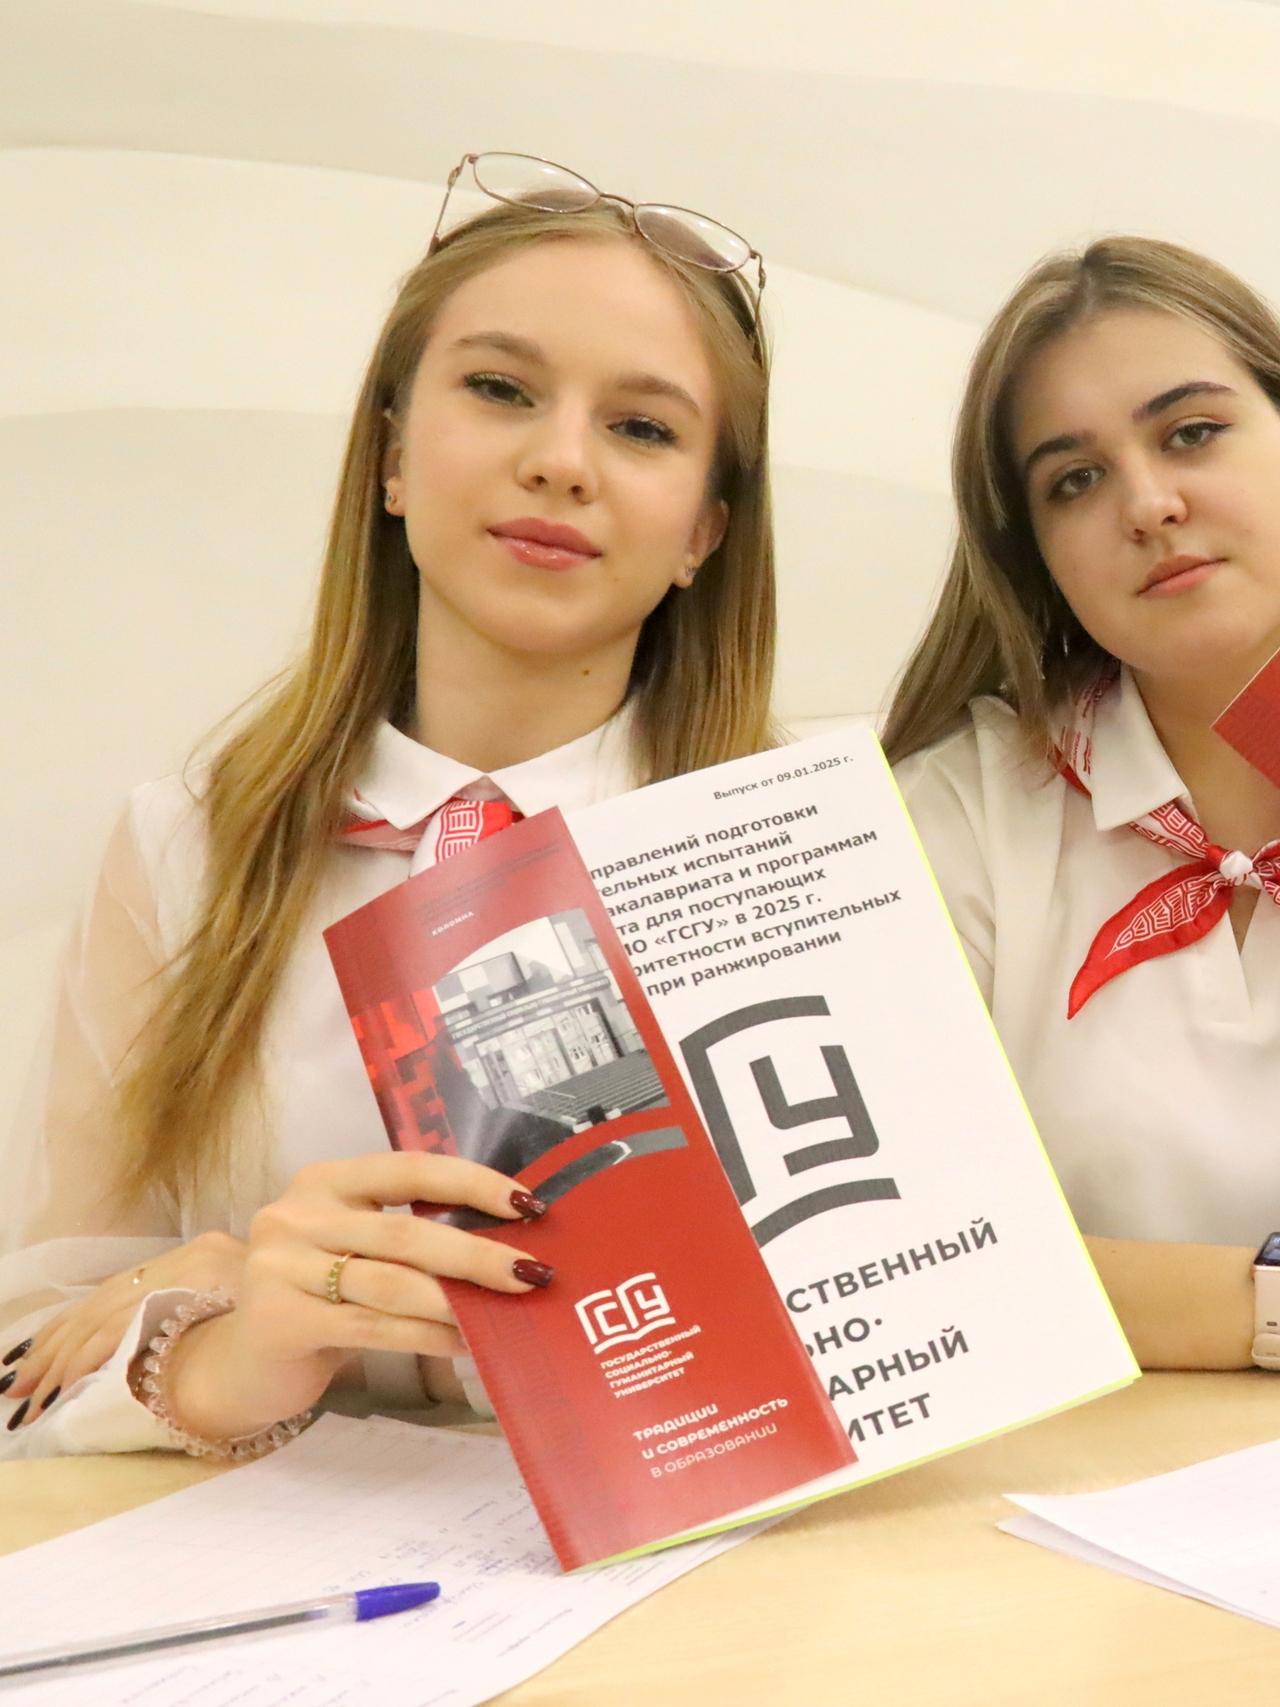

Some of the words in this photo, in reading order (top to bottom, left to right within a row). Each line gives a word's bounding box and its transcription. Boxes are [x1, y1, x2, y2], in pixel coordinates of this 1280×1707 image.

[713, 783, 758, 800] Выпуск
[761, 778, 773, 787] от
[777, 757, 841, 782] 09.01.2025
[705, 805, 818, 844] подготовки
[684, 831, 792, 872] испытаний
[739, 867, 751, 878] и
[757, 831, 877, 874] программам
[646, 909, 683, 930] для
[688, 869, 826, 915] поступающих
[655, 918, 728, 944] «ГСГУ»
[735, 913, 747, 924] в
[752, 895, 800, 919] 2025
[806, 894, 821, 904] г.
[751, 890, 901, 942] вступительных
[647, 976, 686, 996] при
[691, 932, 841, 986] ранжировании
[600, 1325, 701, 1369] ГОСУДАРСТВЕННЫЙ
[605, 1351, 671, 1379] СОЦИАЛЬНО-
[609, 1352, 694, 1388] ГУМАНИТАРНЫЙ
[614, 1367, 684, 1398] УНИВЕРСИТЕТ
[633, 1404, 718, 1441] ТРАДИЦИИ
[656, 1399, 788, 1454] СОВРЕМЕННОСТЬ
[663, 1424, 777, 1473] ОБРАЗОВАНИИ
